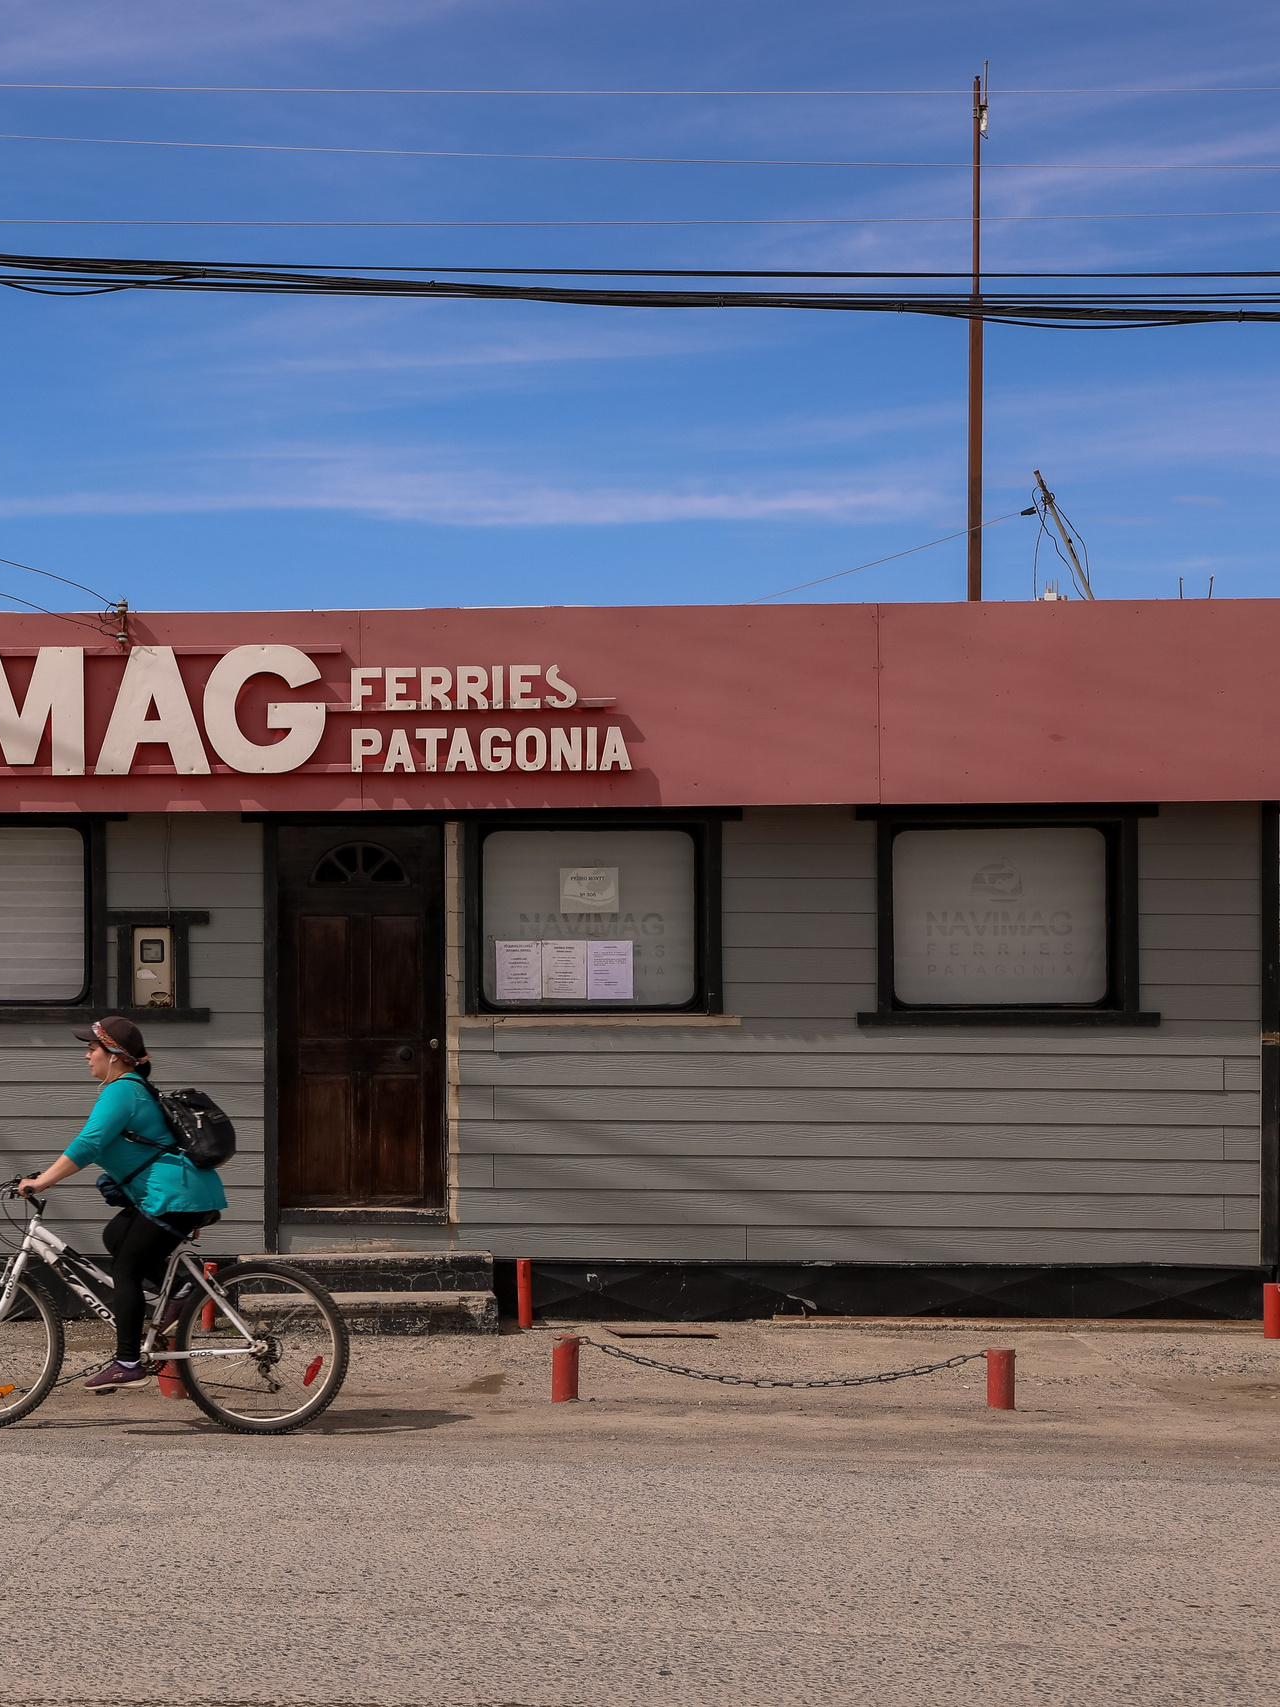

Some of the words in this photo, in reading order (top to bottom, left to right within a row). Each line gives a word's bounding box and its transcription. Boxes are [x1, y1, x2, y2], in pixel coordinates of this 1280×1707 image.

[351, 664, 578, 711] FERRIES
[351, 726, 633, 773] PATAGONIA
[519, 912, 665, 936] NAVIMAG
[927, 911, 1073, 936] NAVIMAG
[927, 943, 1074, 956] FERRIES
[927, 964, 1074, 976] PATAGONIA
[6, 1273, 17, 1299] GIOS
[189, 1350, 214, 1358] GIOS
